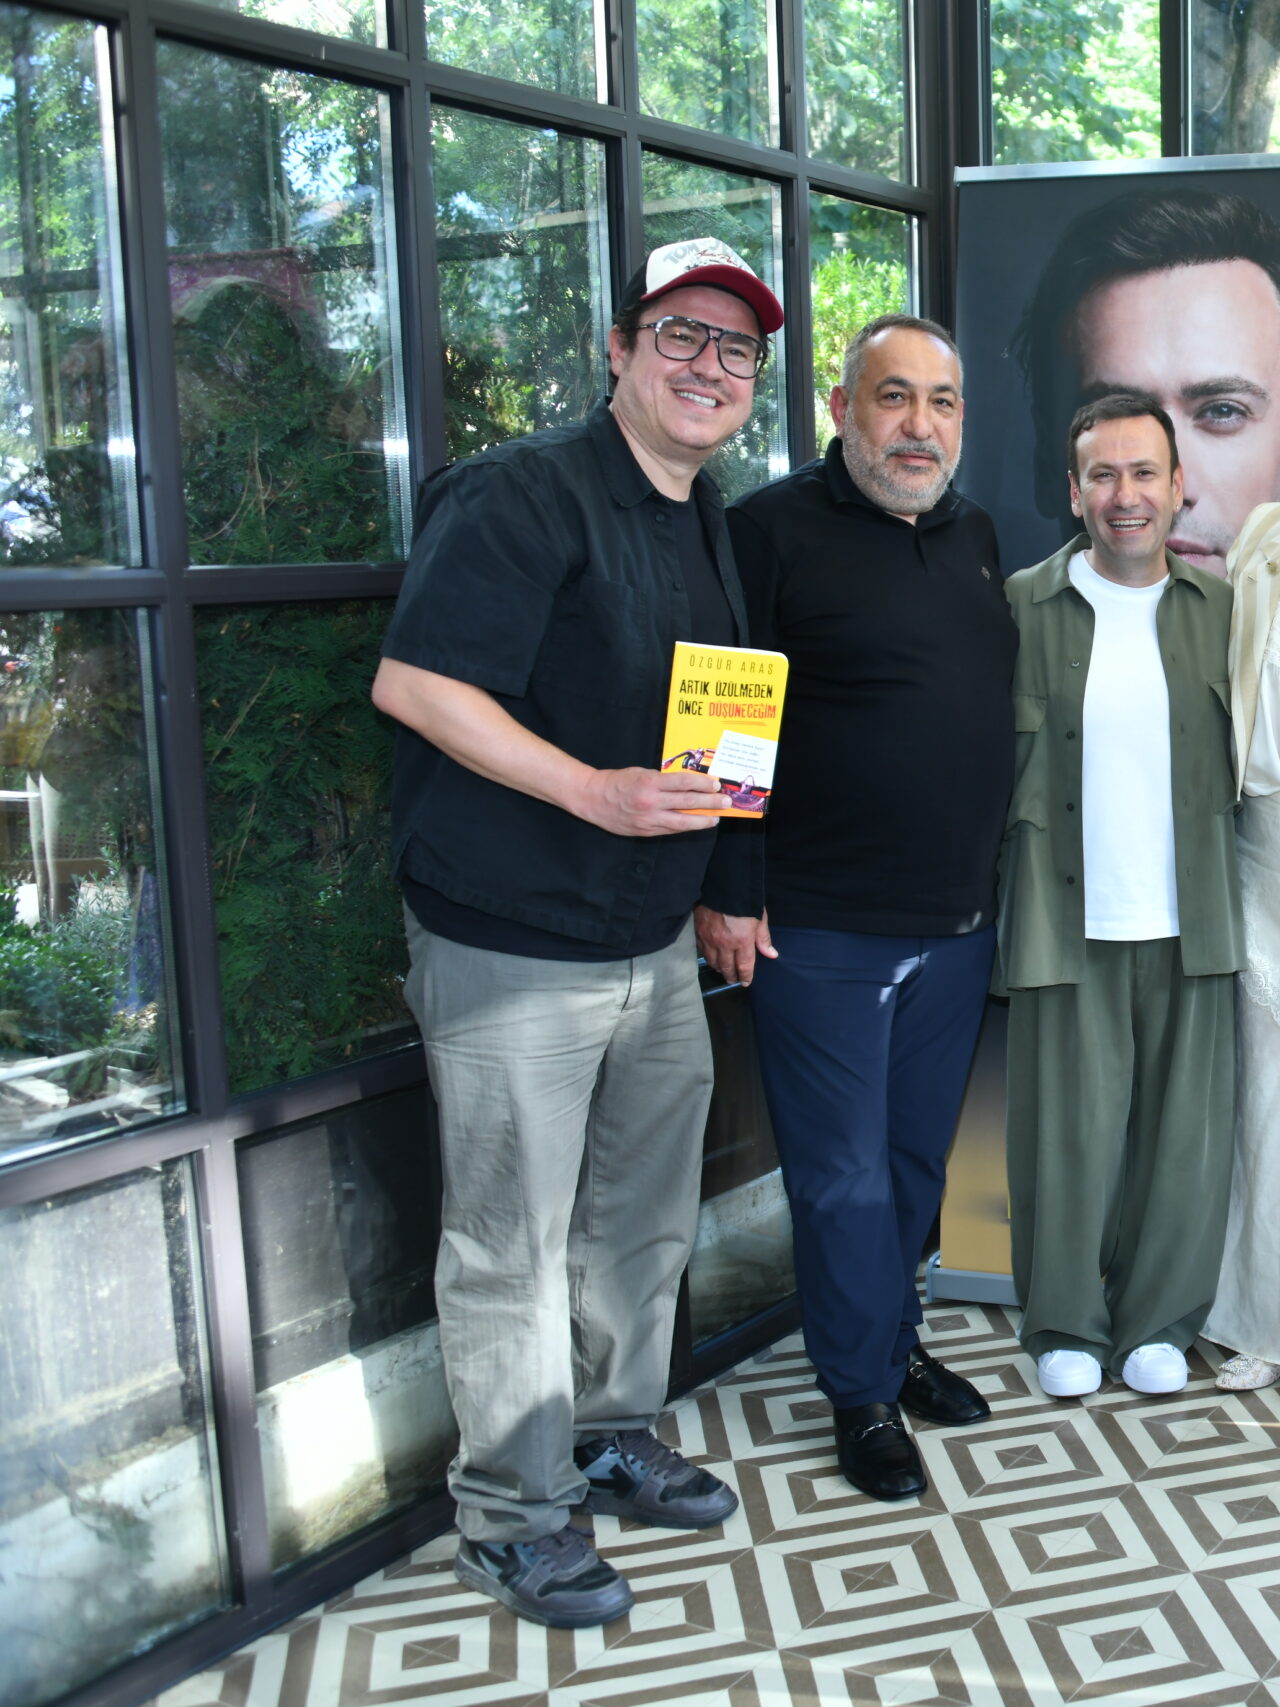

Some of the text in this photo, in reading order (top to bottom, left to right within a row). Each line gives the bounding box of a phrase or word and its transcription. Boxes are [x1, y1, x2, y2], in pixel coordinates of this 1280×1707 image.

[689, 654, 774, 675] ÖZGÜR ARAS
[679, 679, 773, 699] ARTIK ÜZÜLMEDEN
[677, 697, 704, 716] ÖNCE
